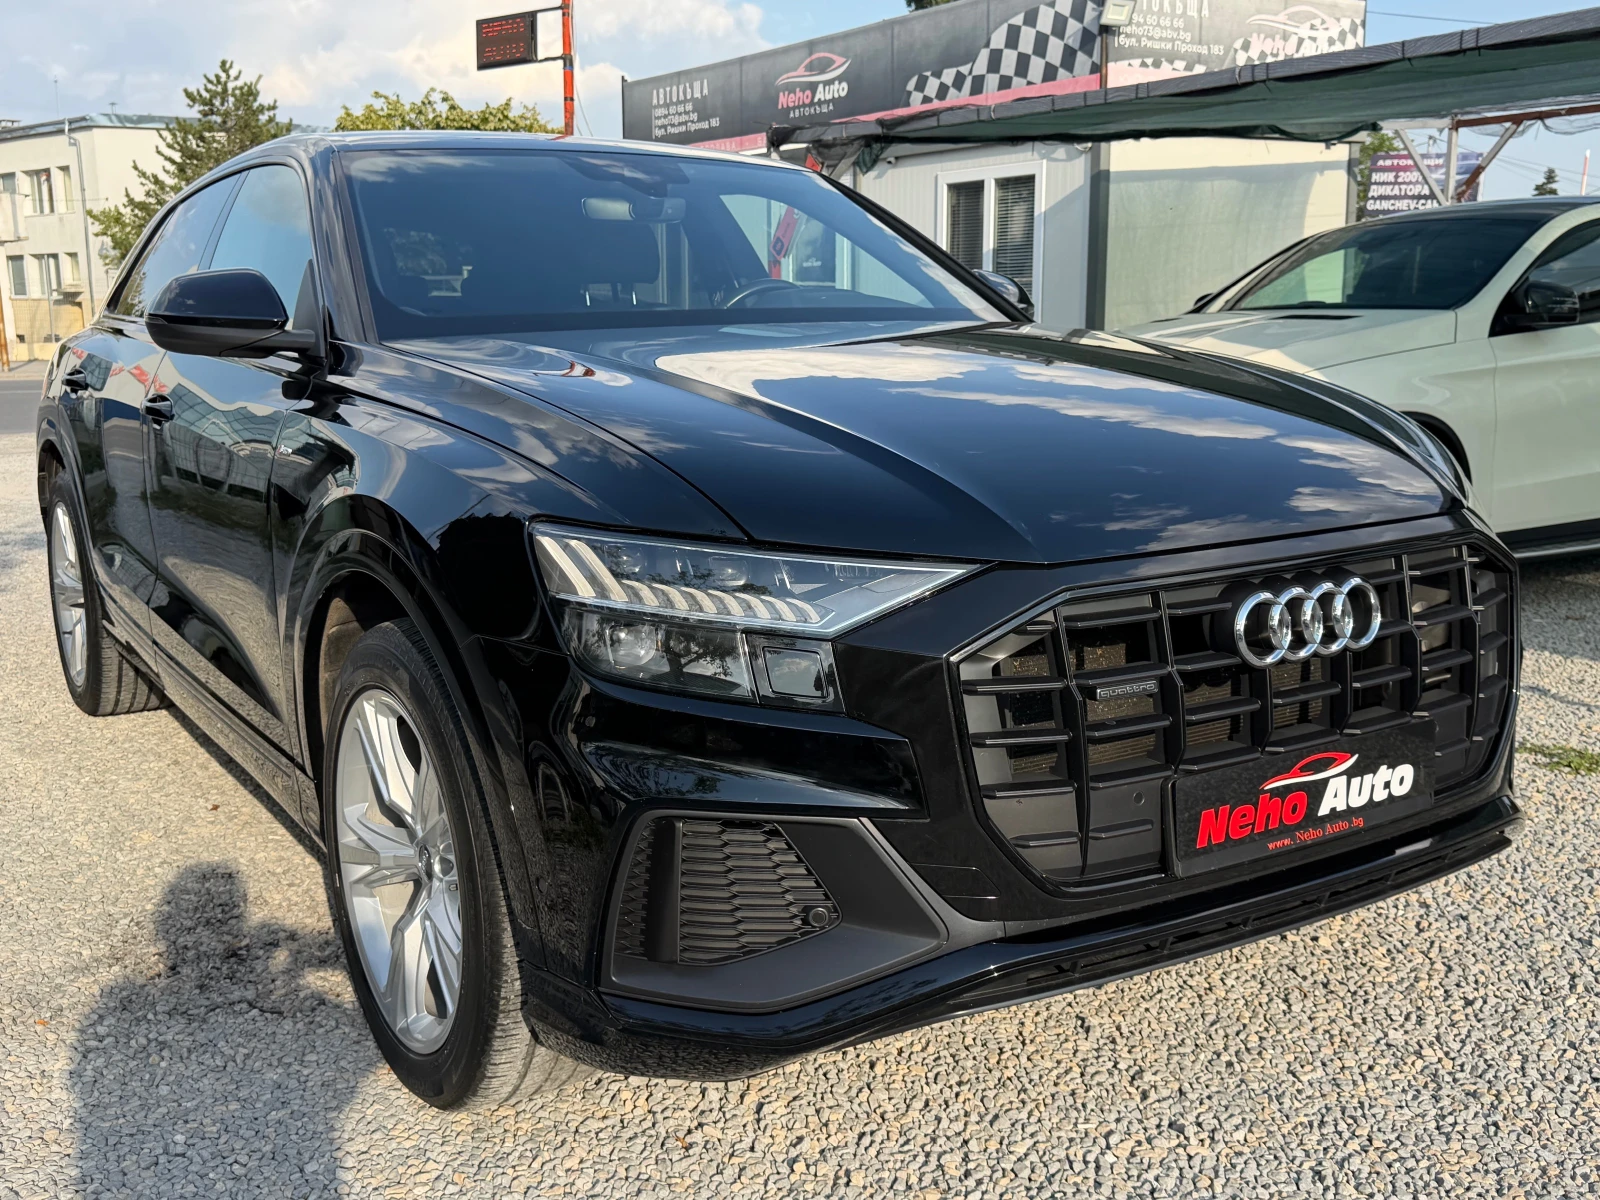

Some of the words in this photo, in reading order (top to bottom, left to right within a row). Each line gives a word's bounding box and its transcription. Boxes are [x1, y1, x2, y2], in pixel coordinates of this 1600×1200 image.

[1131, 13, 1145, 24] 94
[1146, 14, 1158, 26] 60
[1159, 16, 1171, 28] 66
[1172, 18, 1185, 29] 66
[1120, 25, 1192, 42] neho73@abv.bg
[1118, 35, 1139, 48] бул.
[1141, 37, 1173, 50] Ришки
[1174, 41, 1209, 55] Проход
[1209, 44, 1225, 56] 183
[652, 79, 709, 106] АВТОКЪЩА
[777, 87, 813, 110] Neho
[813, 80, 849, 103] Auto
[654, 108, 669, 118] 0894
[669, 105, 677, 115] 60
[677, 103, 685, 113] 66
[685, 102, 694, 112] 66
[789, 102, 835, 119] АВТОКЪЩА
[654, 112, 699, 127] neho73@abv.bg
[667, 123, 687, 135] Ришки
[687, 120, 710, 132] Проход
[709, 117, 721, 128] 183
[1371, 171, 1396, 183] НИК
[1367, 185, 1431, 199] ДИКАТОРА
[1100, 683, 1155, 698] quattro
[1196, 790, 1308, 849] Neho
[1317, 763, 1414, 817] Auto
[1267, 837, 1294, 851] www.
[1295, 828, 1323, 844] Neho
[1325, 820, 1349, 835] Auto
[1350, 816, 1364, 828] .bg
